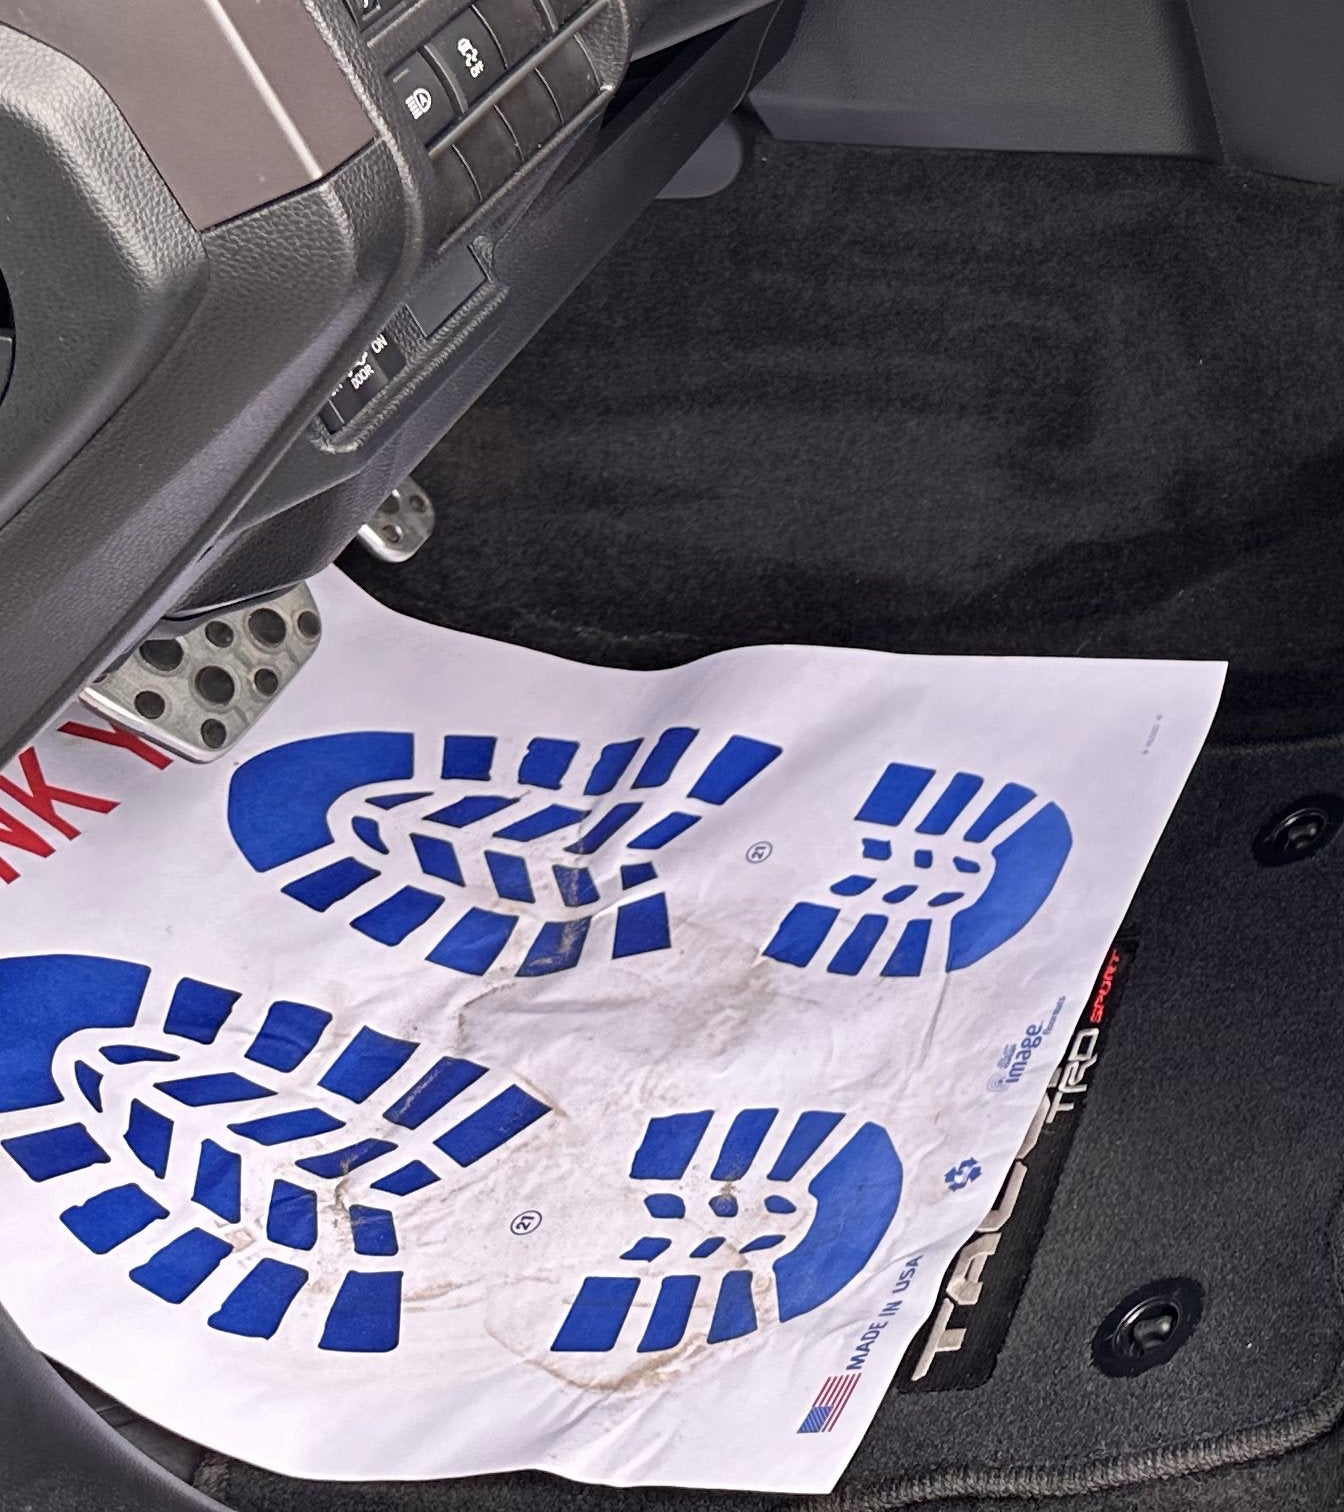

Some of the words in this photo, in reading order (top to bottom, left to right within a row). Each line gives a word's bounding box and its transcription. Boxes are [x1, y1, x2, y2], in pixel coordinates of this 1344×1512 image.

[350, 364, 375, 390] DOOR
[371, 333, 388, 354] ON
[1090, 949, 1120, 1024] SPORT
[1006, 1024, 1042, 1083] image
[1045, 1028, 1099, 1123] TRD
[847, 1321, 888, 1370] MADE
[879, 1300, 903, 1317] IN
[892, 1255, 923, 1294] USA
